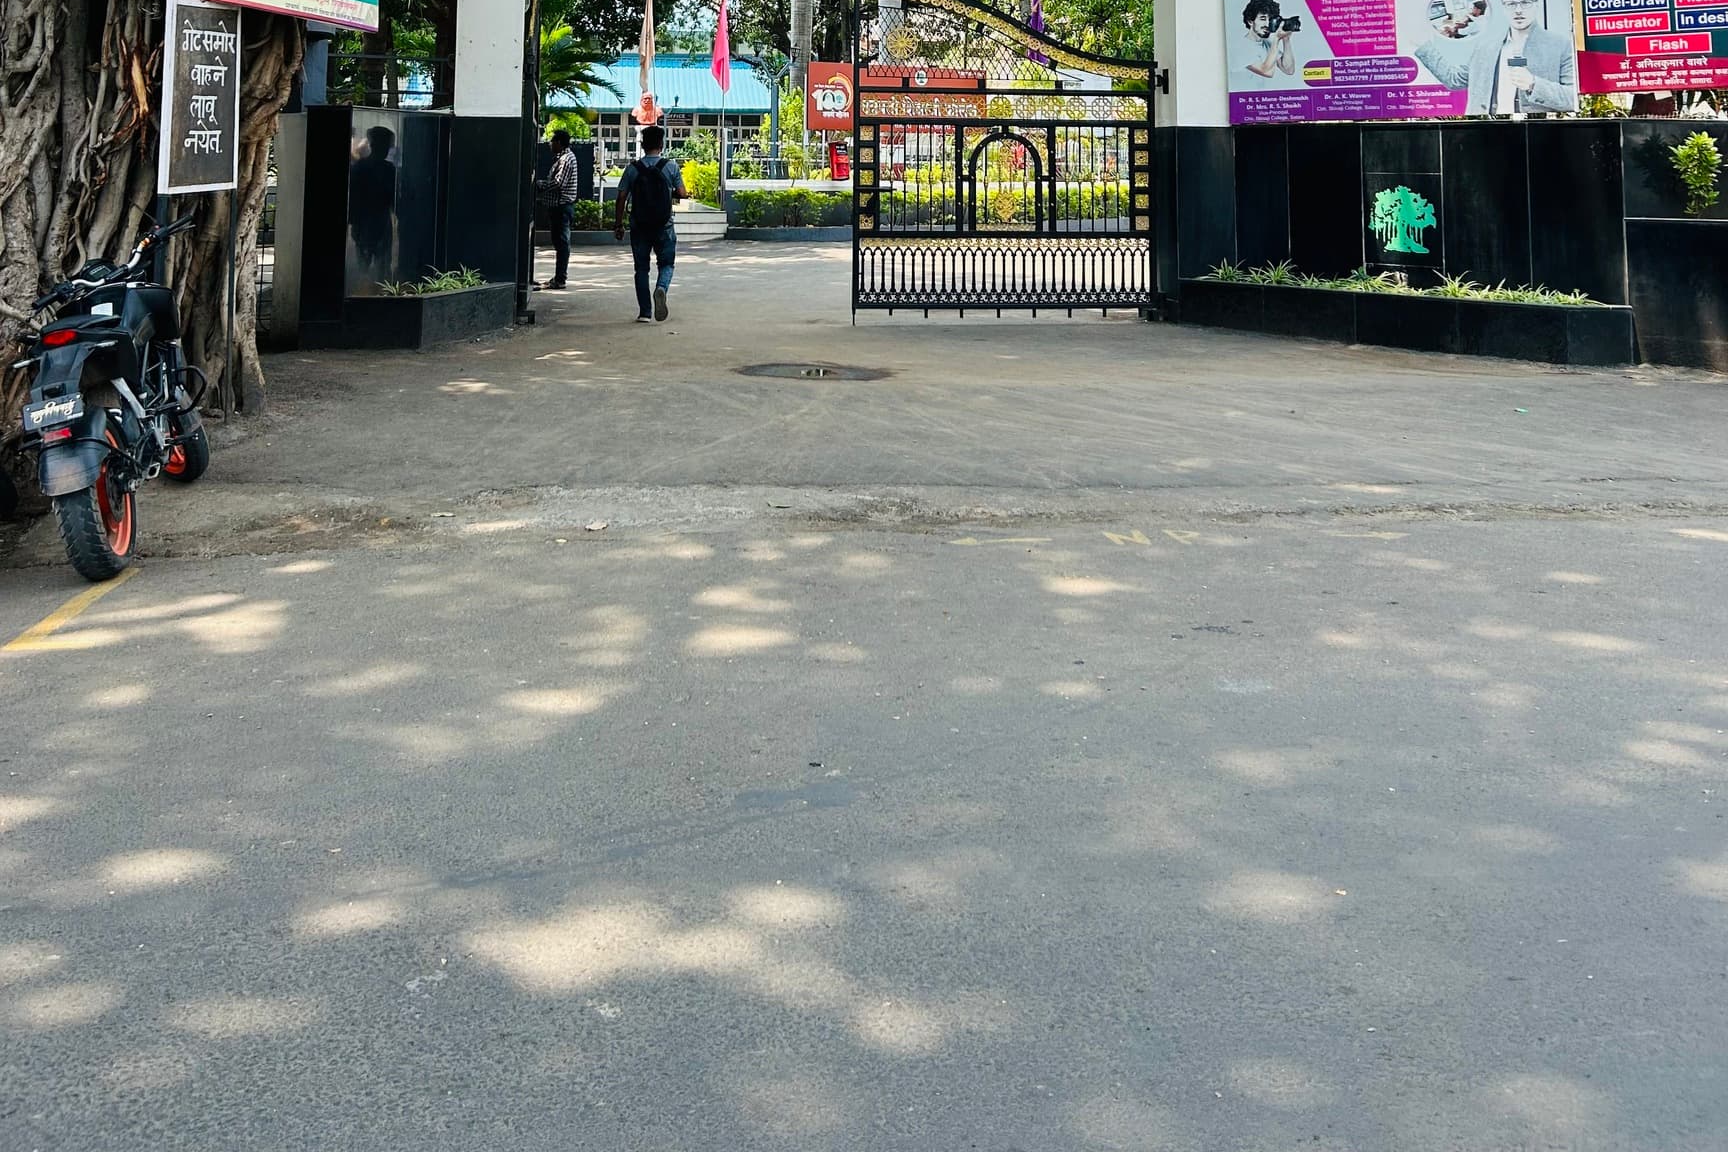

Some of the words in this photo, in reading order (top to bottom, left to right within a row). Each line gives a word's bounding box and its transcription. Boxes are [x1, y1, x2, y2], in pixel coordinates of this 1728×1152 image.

[1594, 16, 1662, 31] illustrator
[1680, 13, 1695, 25] In
[1649, 38, 1689, 51] Flash
[1334, 60, 1344, 68] Dr.
[1345, 59, 1371, 68] Sampat
[1371, 58, 1400, 67] Pimpale
[1620, 59, 1632, 69] डॉ.
[1636, 58, 1684, 70] अनिलकुमार
[190, 55, 228, 87] वाहने
[811, 89, 849, 111] 100
[1415, 90, 1451, 98] Shivankar
[189, 95, 219, 125] लावू
[184, 119, 223, 154] नयेत.
